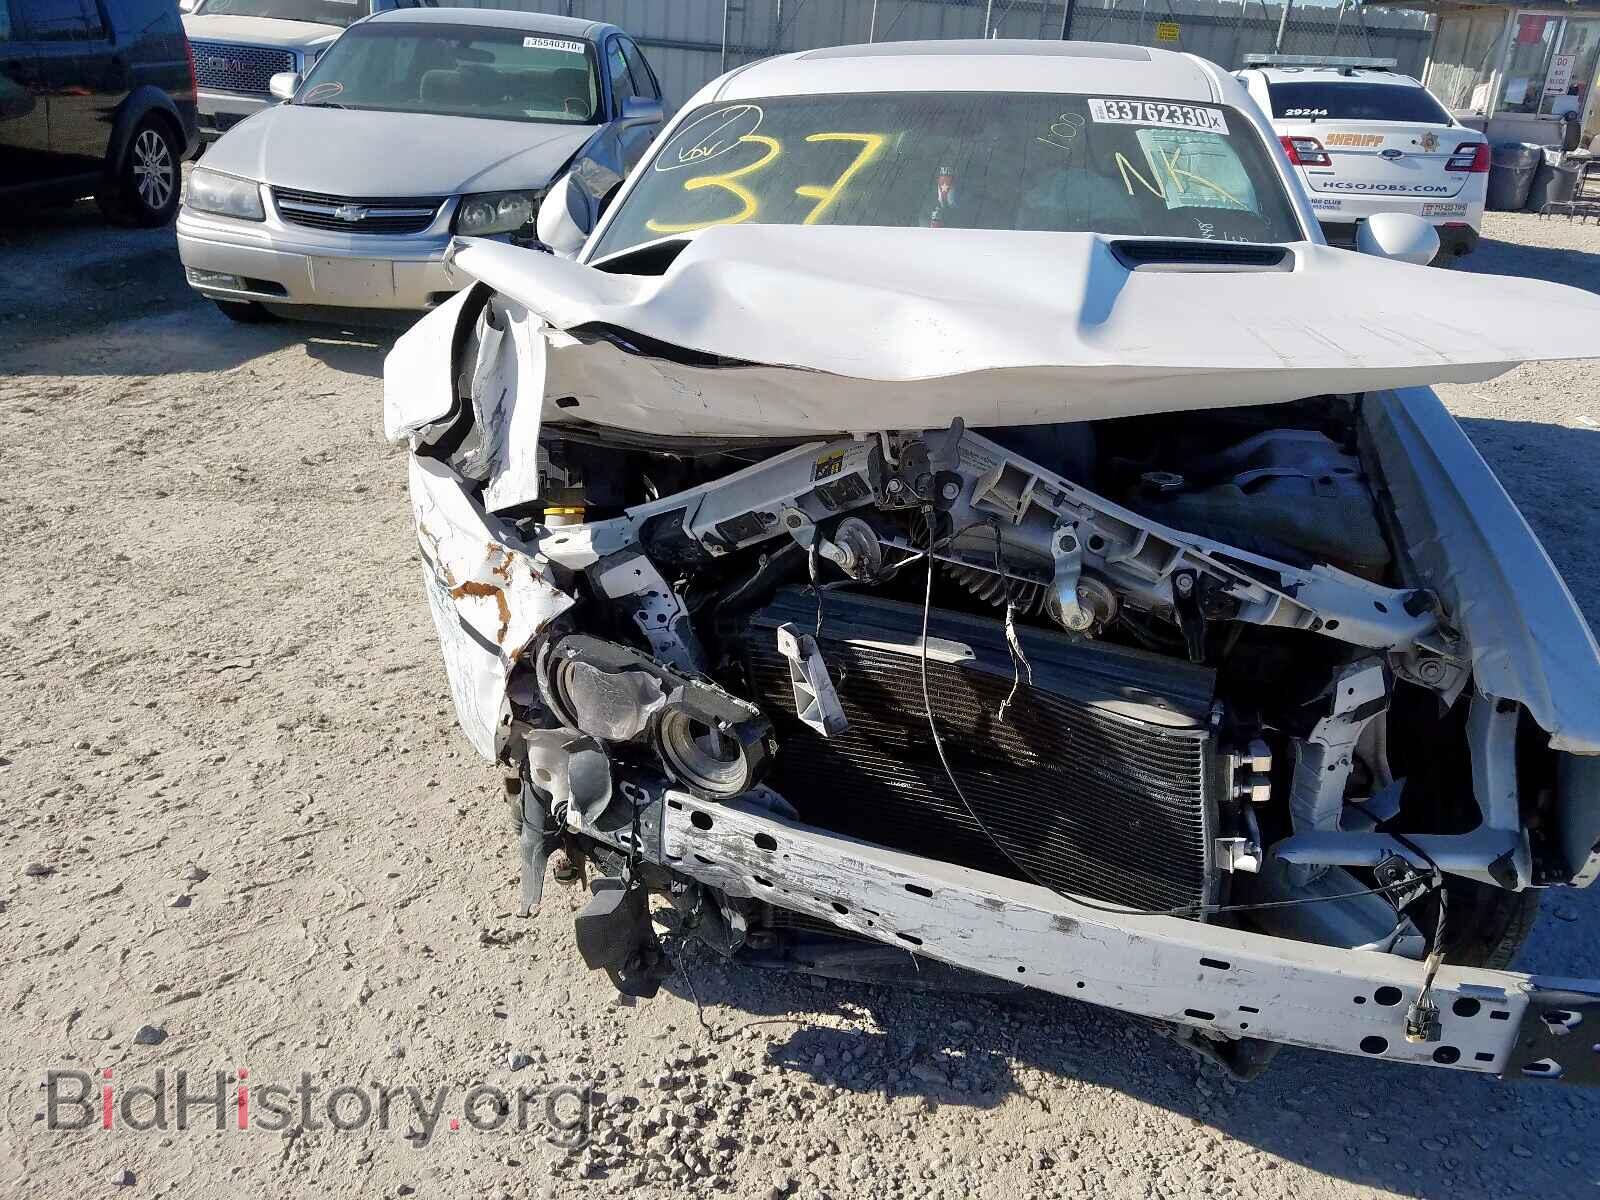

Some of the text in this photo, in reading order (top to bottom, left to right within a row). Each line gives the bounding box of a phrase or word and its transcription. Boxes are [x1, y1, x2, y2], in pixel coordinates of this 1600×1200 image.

[1105, 101, 1210, 127] 33762330
[1285, 107, 1328, 116] 29244
[1325, 133, 1385, 147] SHERIFF
[1323, 181, 1448, 193] HCSOJOBS.COM
